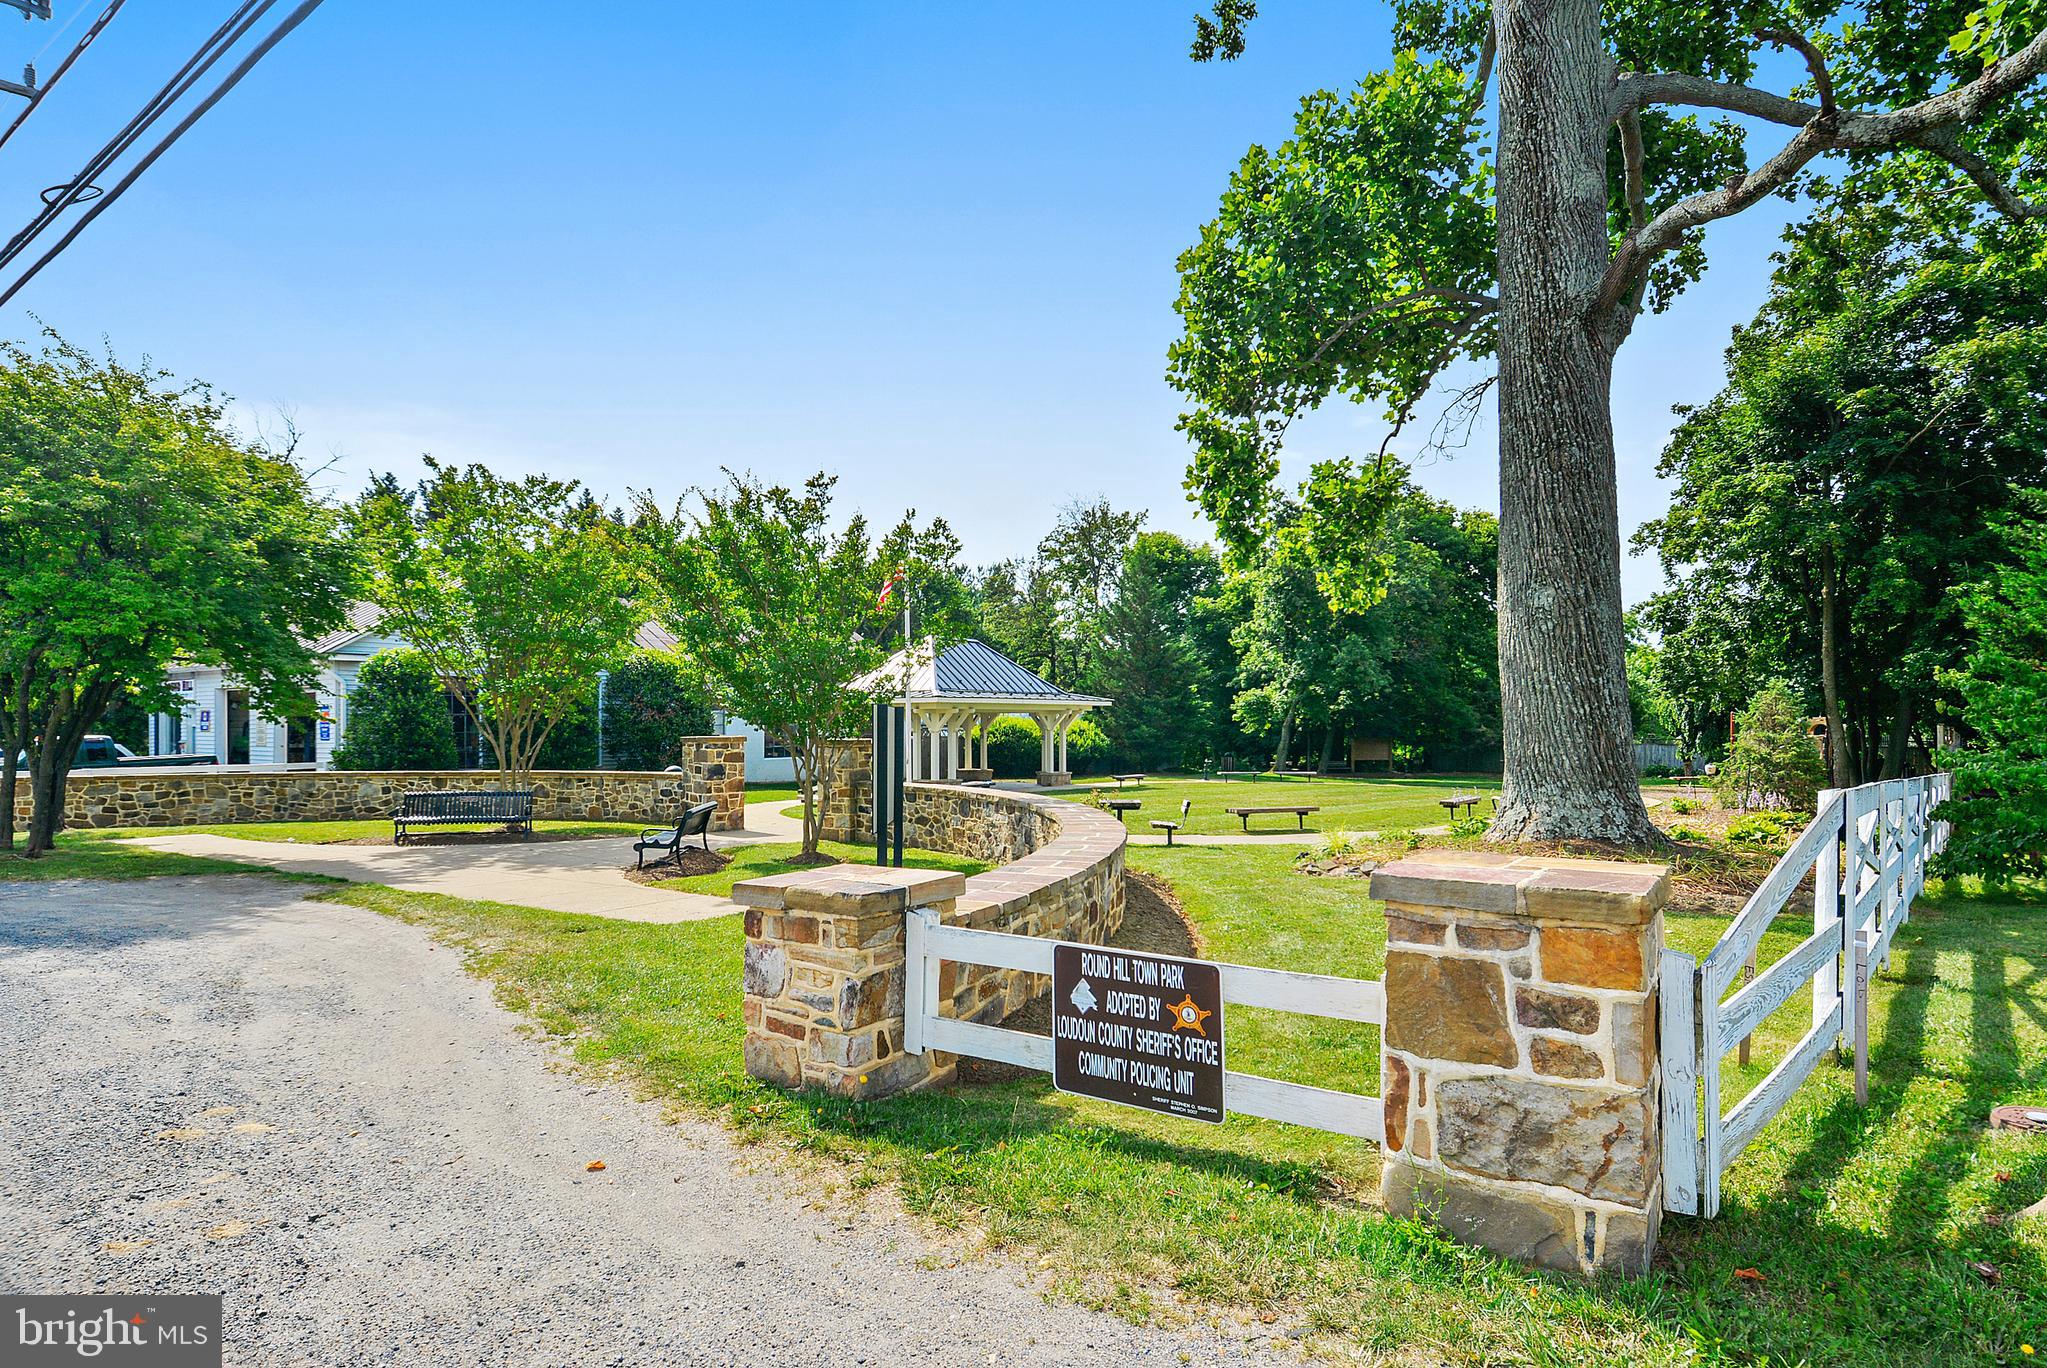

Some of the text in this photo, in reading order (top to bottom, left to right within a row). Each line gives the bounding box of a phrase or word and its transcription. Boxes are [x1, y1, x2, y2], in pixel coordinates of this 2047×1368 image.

[1081, 952, 1185, 990] ROUND HILL TOWN PARK
[1106, 990, 1161, 1022] ADOPTED BY
[1057, 1015, 1219, 1066] LOUDOUN COUNTY SHERIFF'S OFFICE
[1078, 1051, 1195, 1096] COMMUNITY POLICING UNIT
[1151, 1095, 1170, 1104] SHERIFF
[1170, 1099, 1191, 1109] STEPHEN
[1170, 1105, 1186, 1113] MARCH
